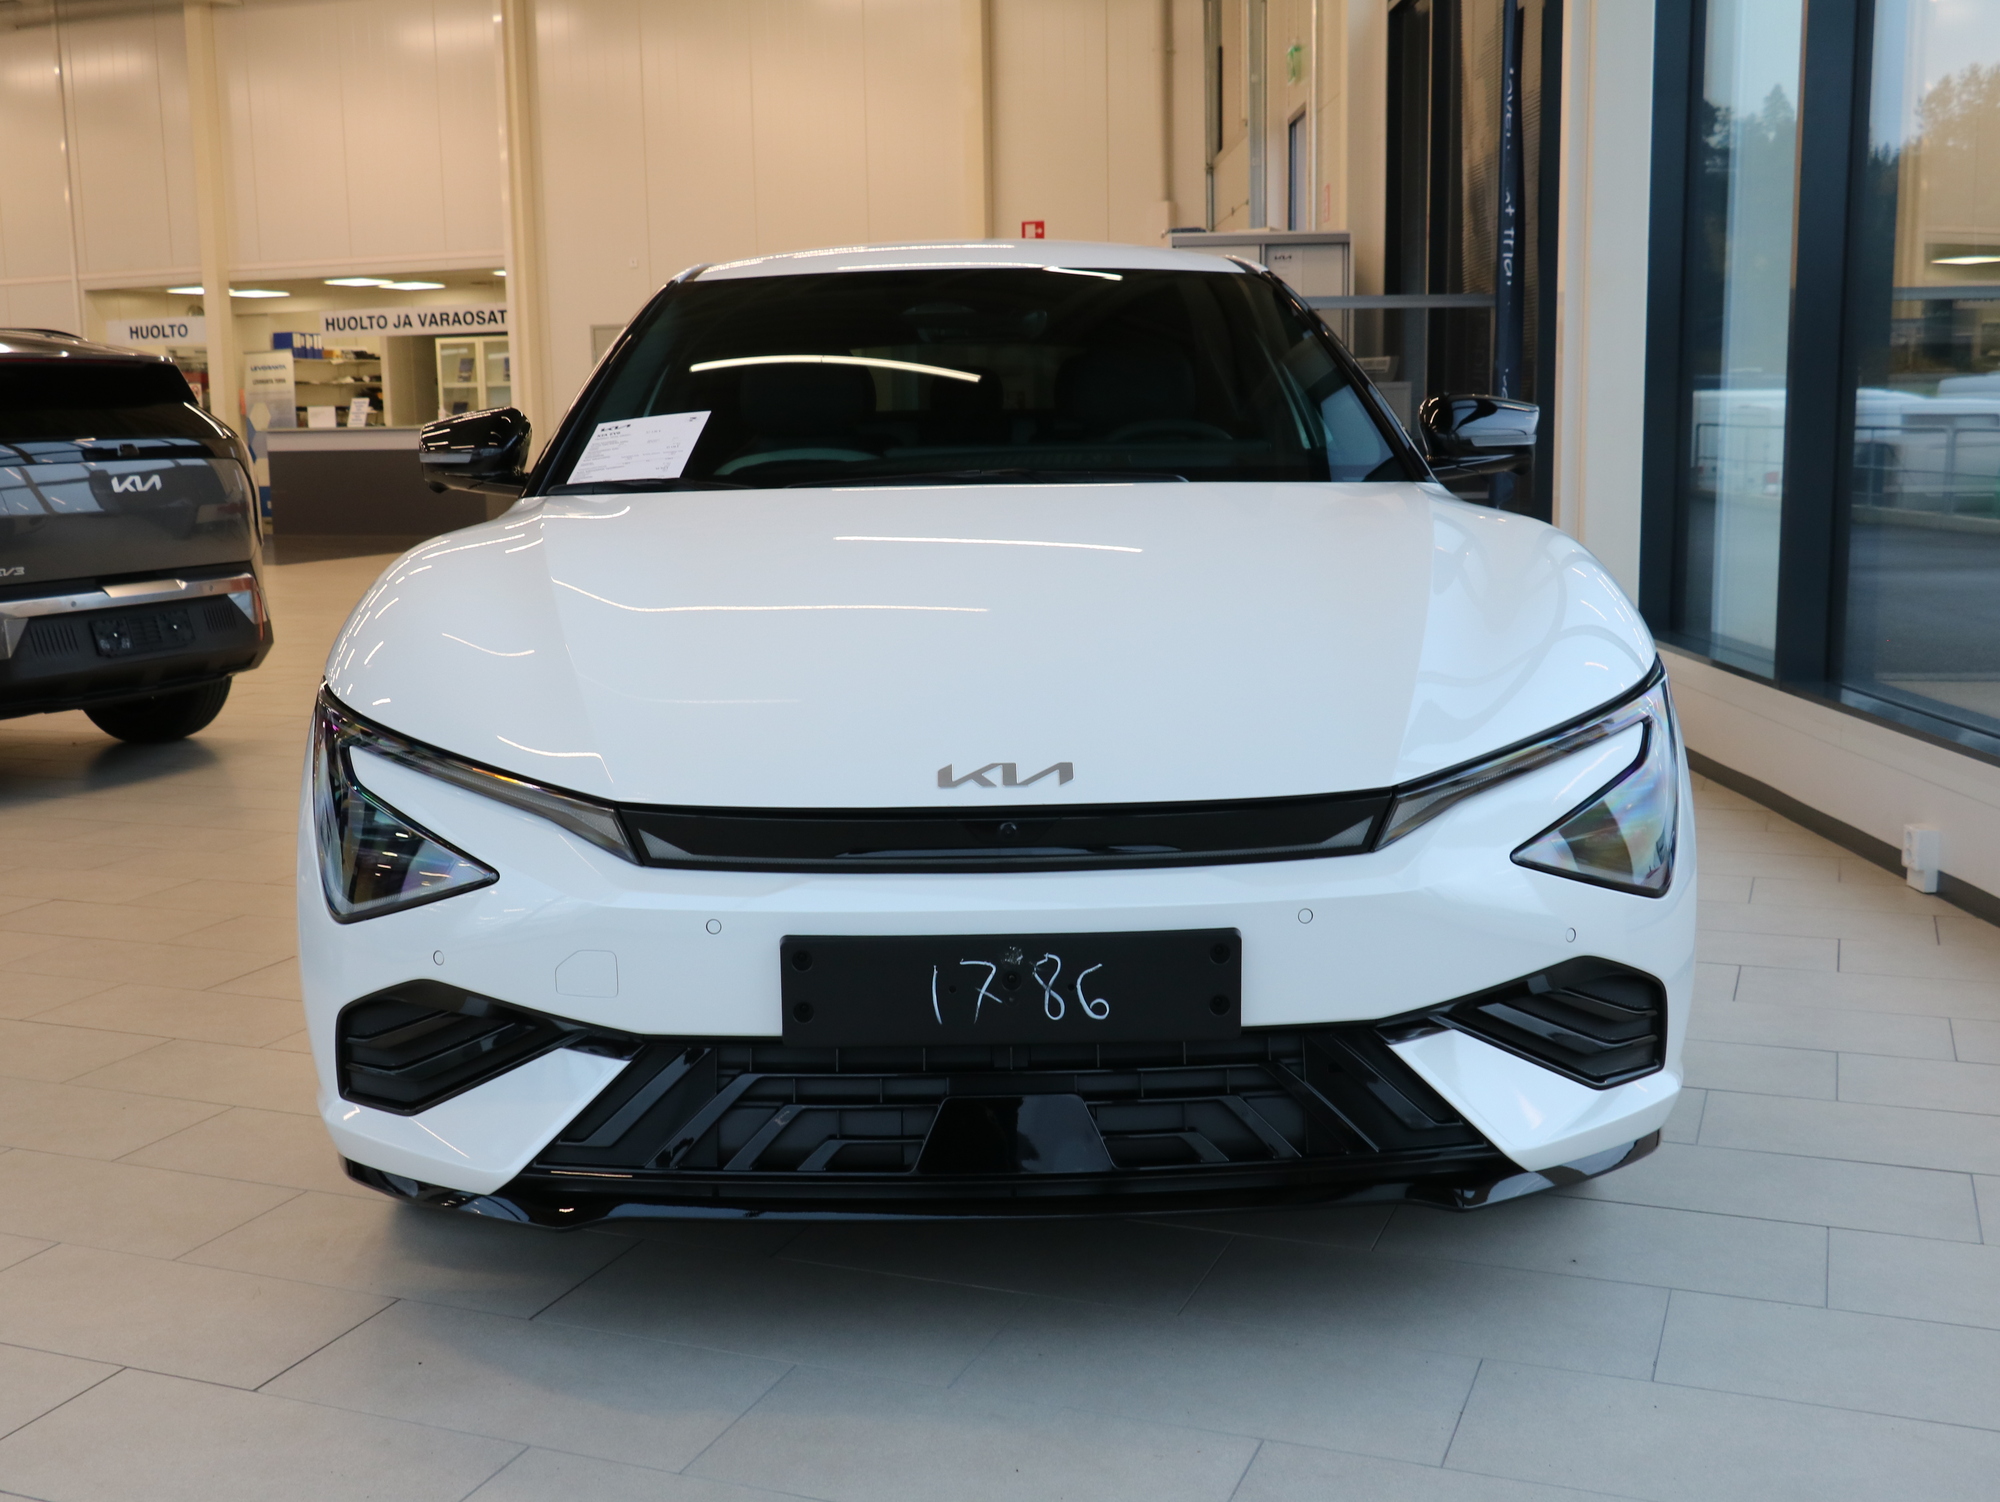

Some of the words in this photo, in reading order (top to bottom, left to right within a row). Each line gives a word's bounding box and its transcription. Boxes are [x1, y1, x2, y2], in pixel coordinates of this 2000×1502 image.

[129, 323, 188, 340] HUOLTO
[325, 315, 388, 332] HUOLTO
[393, 314, 413, 329] JA
[418, 310, 507, 328] VARAOSAT
[111, 474, 162, 493] KIA
[937, 761, 1074, 788] KIA
[931, 952, 1109, 1024] 1786
